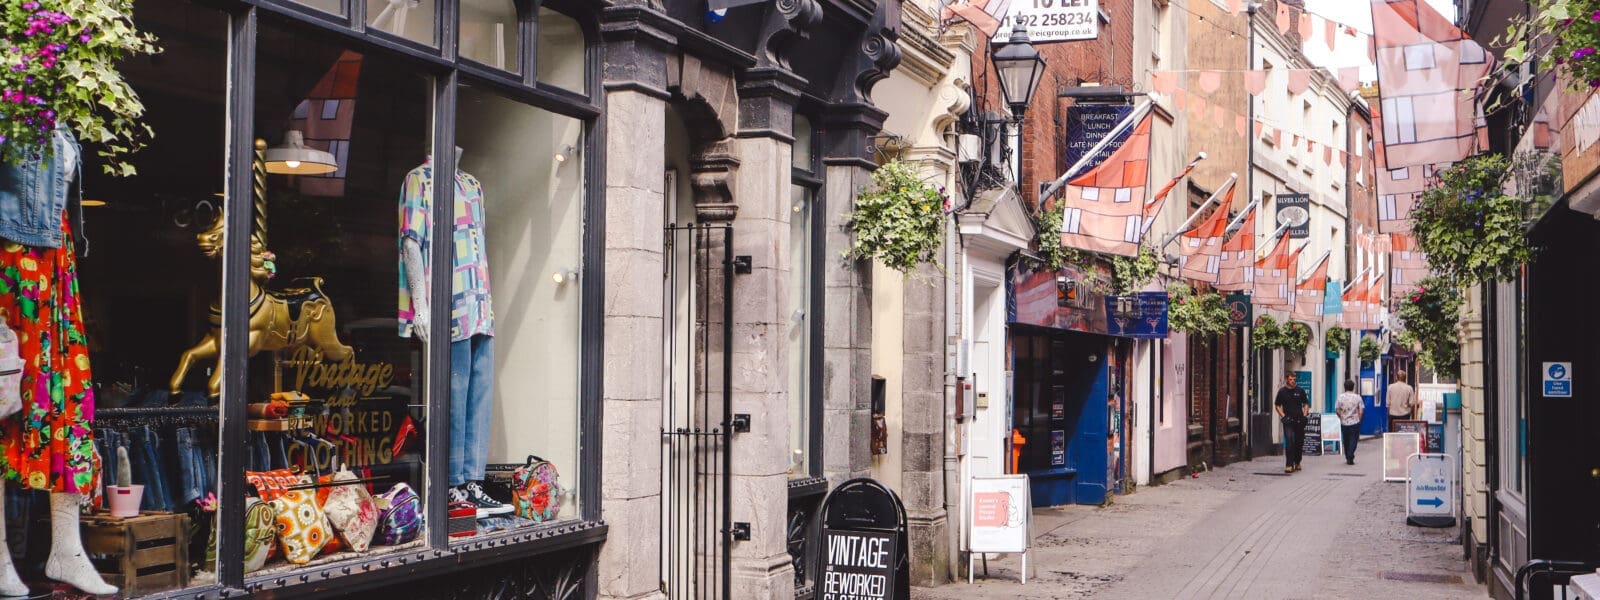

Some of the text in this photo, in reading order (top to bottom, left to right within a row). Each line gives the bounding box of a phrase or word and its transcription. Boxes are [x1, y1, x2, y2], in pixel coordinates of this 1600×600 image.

[1000, 12, 1092, 27] 192 258234
[995, 28, 1092, 39] prop@eicgroup.co.uk
[290, 345, 393, 396] Vintage
[326, 391, 358, 407] and
[288, 411, 392, 436] REWORKED
[288, 437, 392, 471] CLOTHING
[828, 534, 890, 569] VINTAGE
[824, 571, 886, 597] REWORKED
